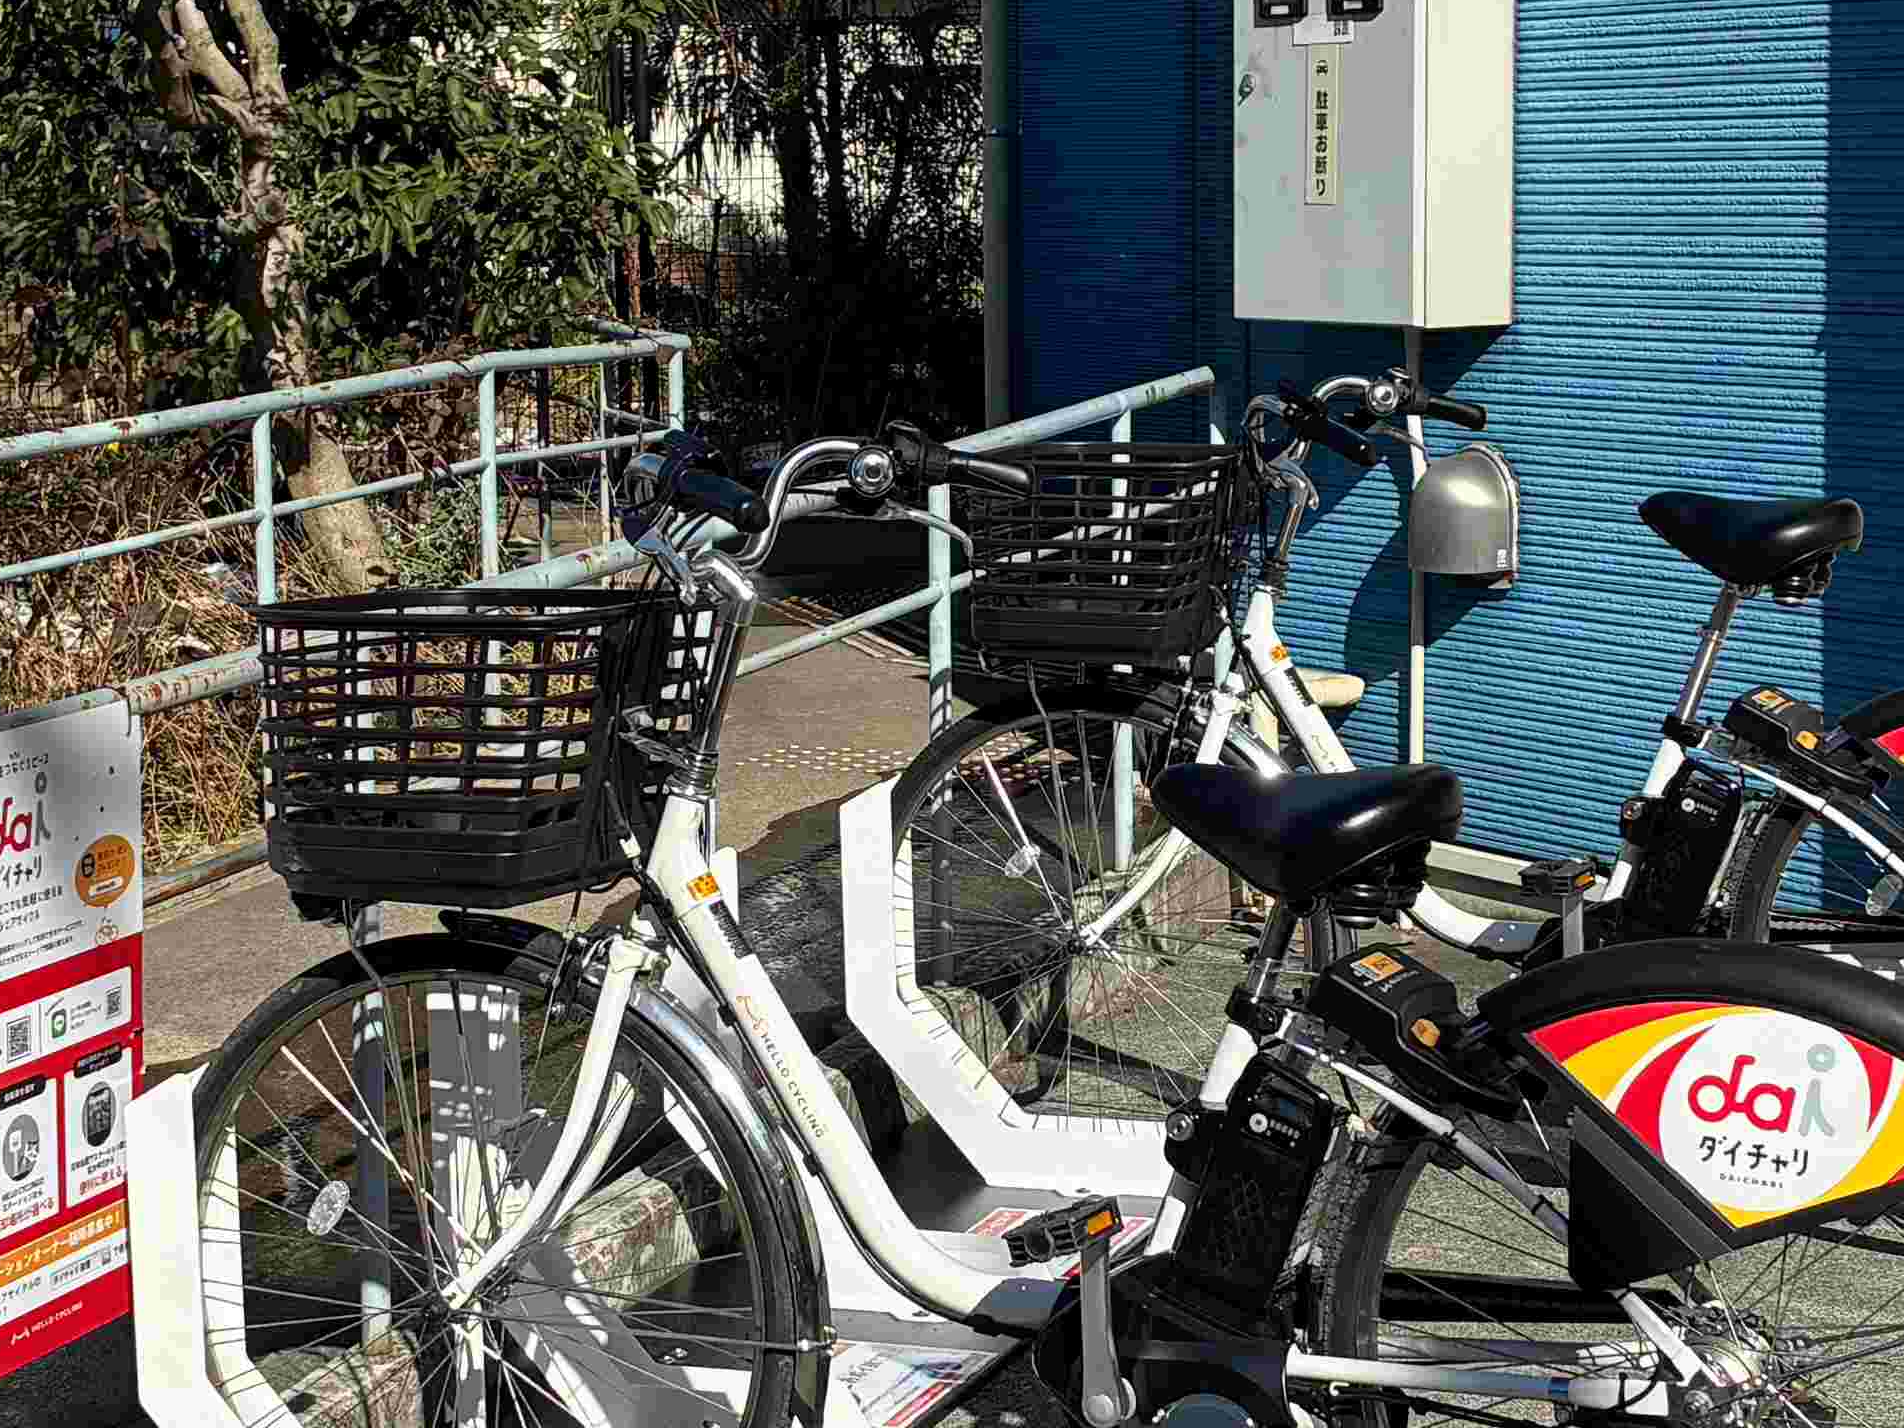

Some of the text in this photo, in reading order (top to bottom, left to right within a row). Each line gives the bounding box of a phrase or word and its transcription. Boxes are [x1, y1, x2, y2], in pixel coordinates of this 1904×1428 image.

[1315, 89, 1329, 197] 駐車お断り
[761, 1032, 825, 1138] HELLO CYCLING
[1699, 1135, 1809, 1177] ダイチャリ
